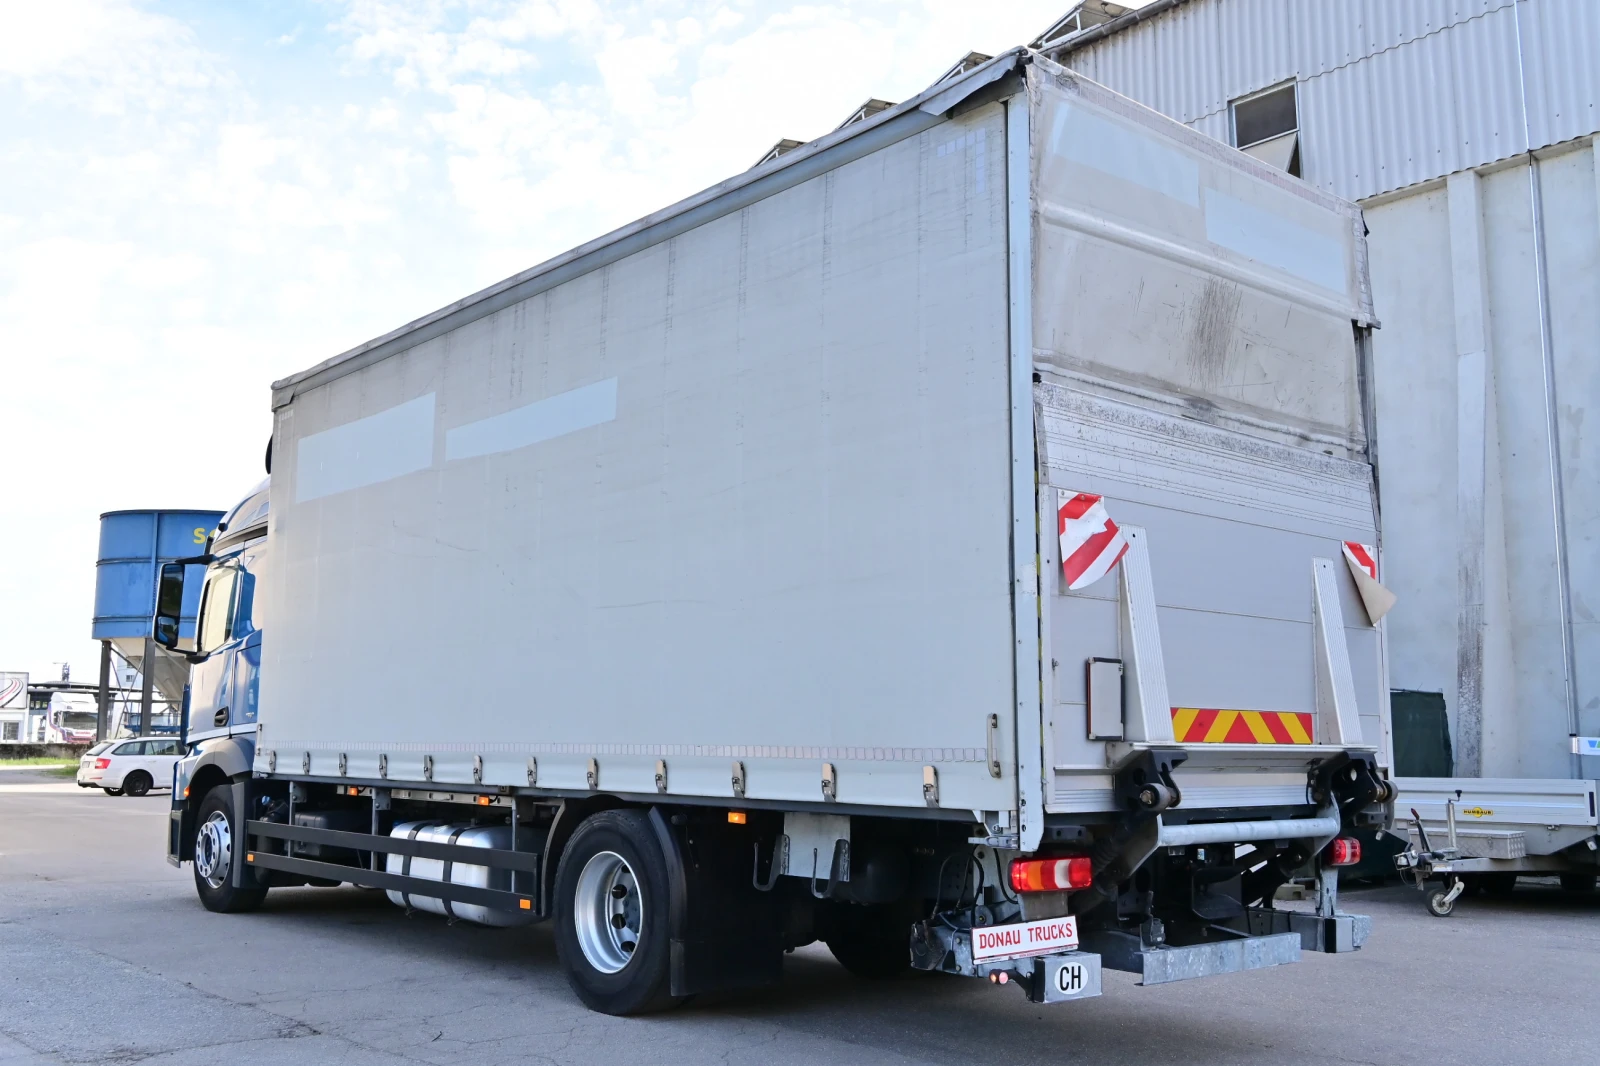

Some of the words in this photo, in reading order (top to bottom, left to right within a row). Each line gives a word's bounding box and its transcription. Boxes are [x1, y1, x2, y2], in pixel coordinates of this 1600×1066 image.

[979, 929, 1021, 949] DONAU
[1027, 923, 1073, 942] TRUCKS
[1059, 965, 1081, 991] CH
